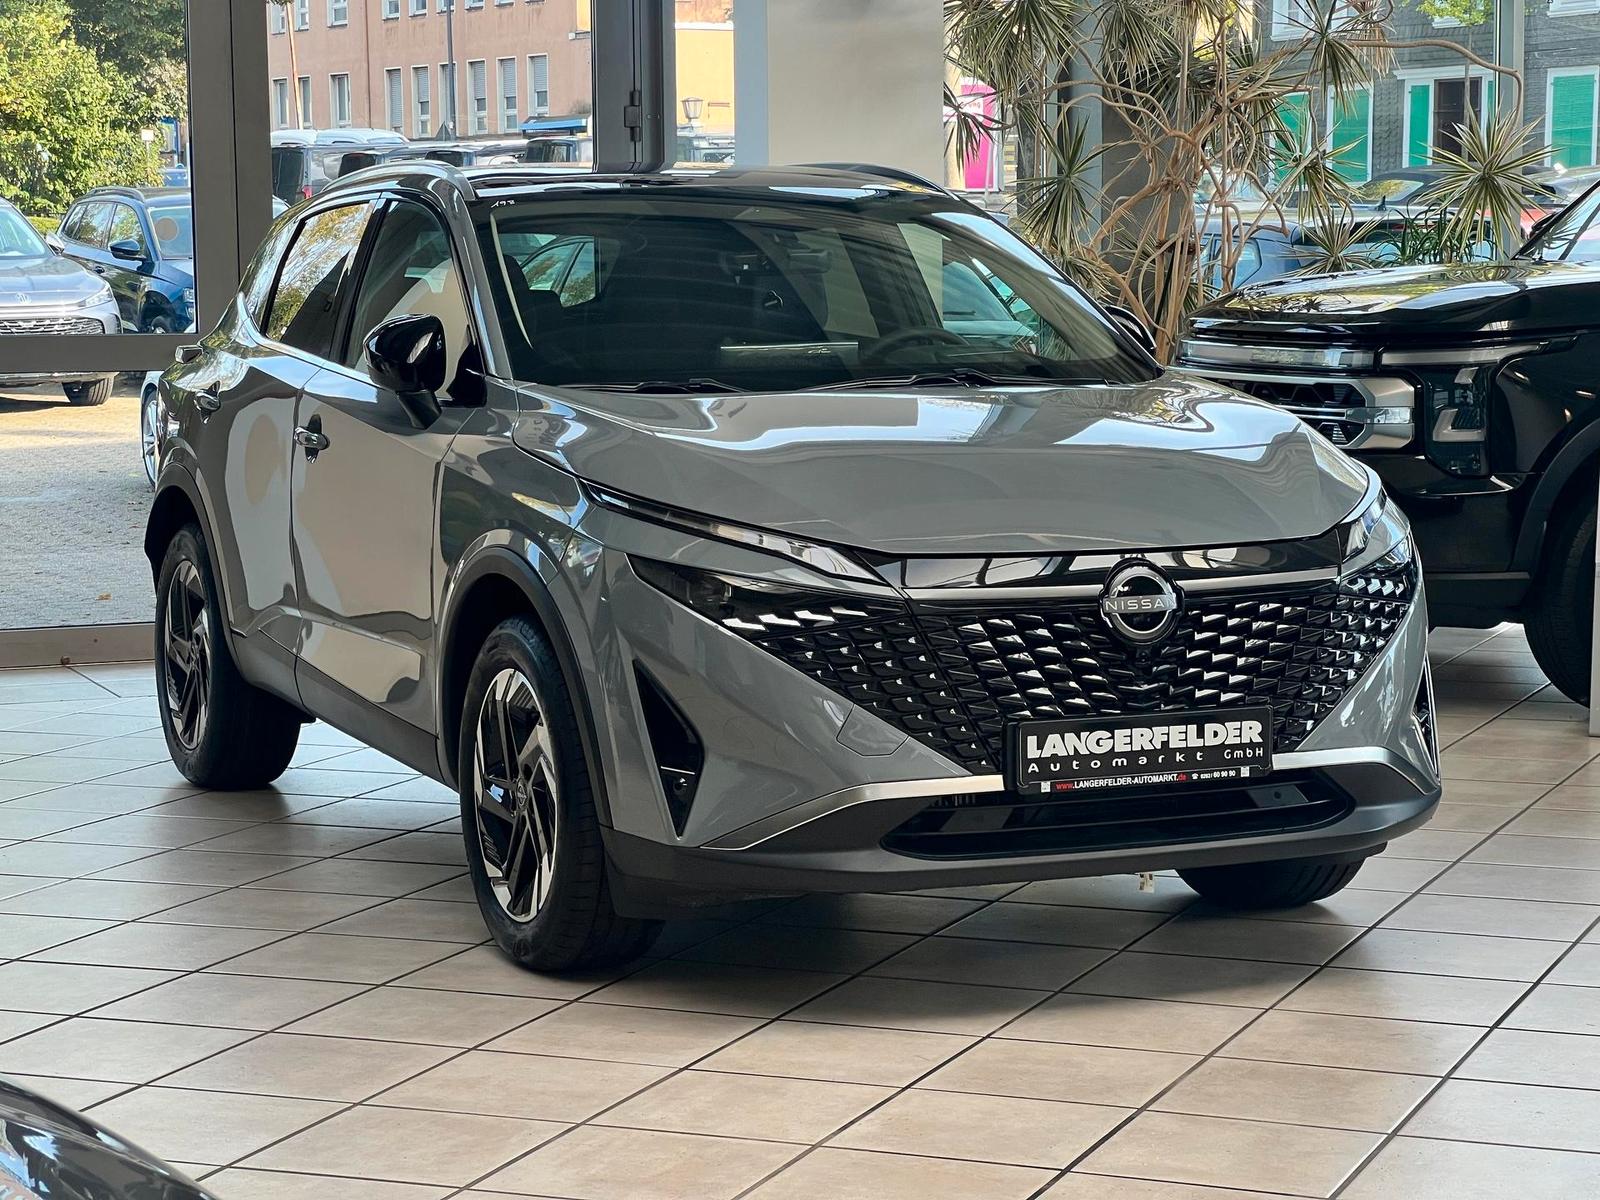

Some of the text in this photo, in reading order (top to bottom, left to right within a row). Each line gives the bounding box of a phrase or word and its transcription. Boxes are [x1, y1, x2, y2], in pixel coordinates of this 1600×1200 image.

[1105, 597, 1175, 611] NISSAN
[1027, 720, 1263, 759] LANGERFELDER
[1028, 747, 1263, 774] Automarkt GmbH
[1056, 773, 1187, 790] www.LANGERFELDER-AUTOMARKT.de
